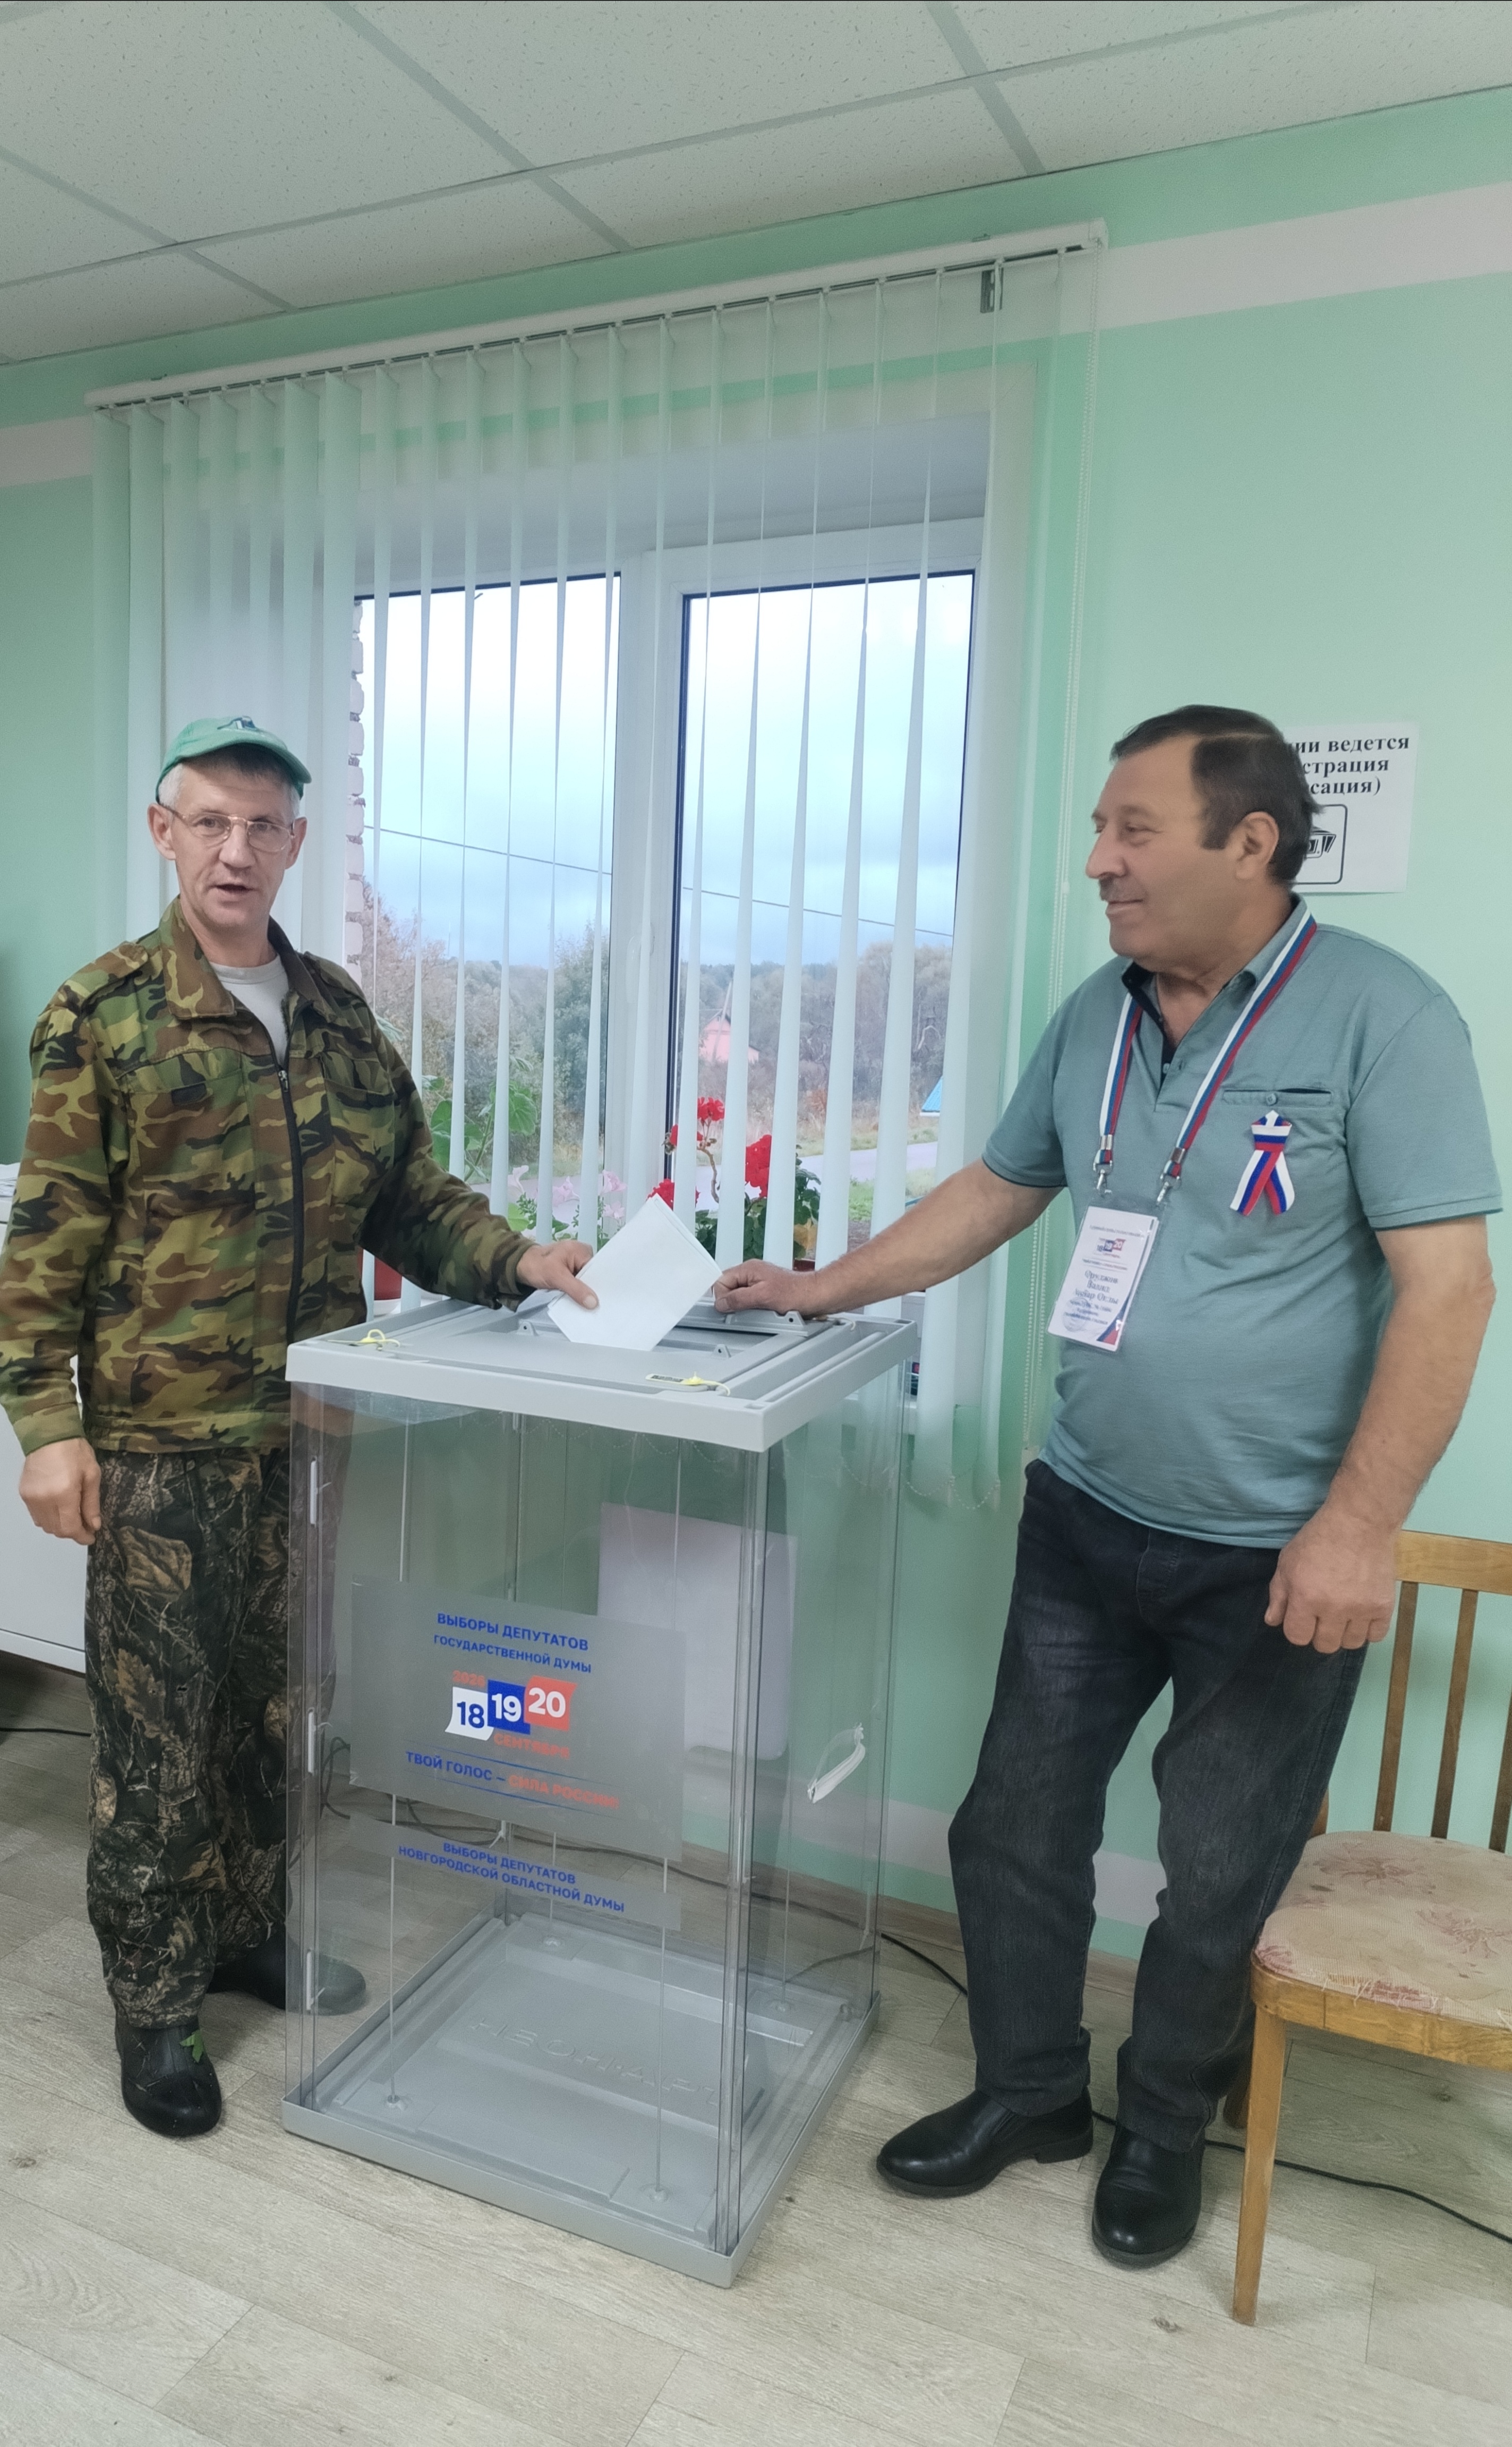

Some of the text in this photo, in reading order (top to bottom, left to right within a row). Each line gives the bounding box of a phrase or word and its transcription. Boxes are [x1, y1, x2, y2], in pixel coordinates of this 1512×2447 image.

[1328, 737, 1410, 753] ведется
[1303, 760, 1389, 778] страция
[1310, 776, 1381, 796] сация)
[1113, 1240, 1123, 1249] 20
[437, 1613, 589, 1651] ВЫБОРЫ ДЕПУТАТОВ
[434, 1634, 592, 1673] ГОСУДАРСТВЕННОЙ ДУМЫ
[452, 1670, 486, 1687] 2026
[457, 1687, 566, 1728] 18 19 20
[493, 1733, 570, 1760] СЕНТЯБРЯ
[406, 1751, 442, 1770] ТВОЙ
[446, 1760, 492, 1781] ГОЛОС
[508, 1775, 549, 1794] СИЛА
[398, 1845, 625, 1913] НОВГОРОДСКОЙ ОБЛАСТНОЙ ДУМЫ
[443, 1842, 576, 1885] ВЫБОРЫ ДЕПУТАТОВ
